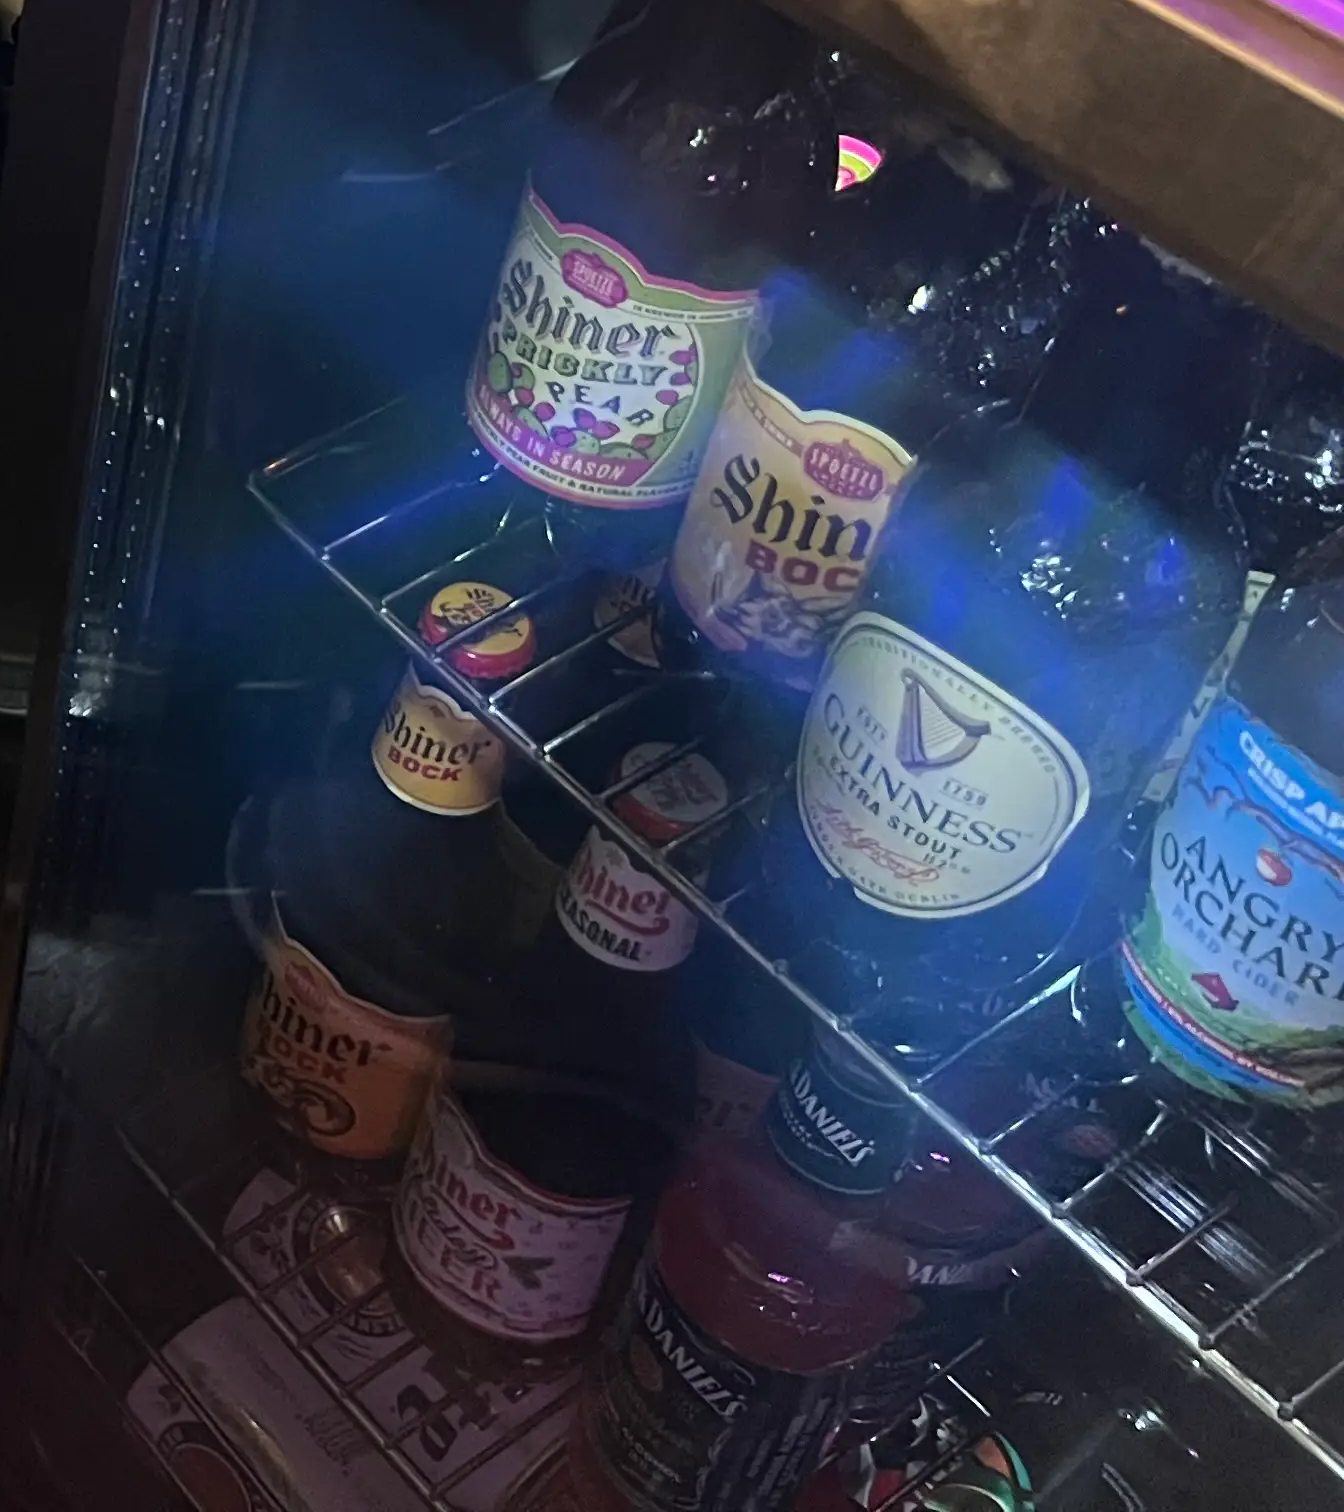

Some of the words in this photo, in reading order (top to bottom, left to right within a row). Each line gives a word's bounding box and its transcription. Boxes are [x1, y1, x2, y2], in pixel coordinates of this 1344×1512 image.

[500, 316, 668, 386] PRICKLY
[501, 257, 681, 358] Shiner
[545, 380, 654, 427] PEAR
[526, 432, 546, 459] IN
[549, 448, 626, 482] SEASON
[383, 695, 491, 767] Shiner
[386, 746, 462, 782] BOCK
[823, 692, 1023, 854] GUINNESS
[1238, 729, 1307, 801] CRISP
[828, 754, 882, 817] EXTRA
[886, 815, 963, 860] STOUT
[942, 779, 988, 807] 1759
[1160, 831, 1344, 1003] ORCHAR
[1185, 835, 1344, 964] ANGRY
[1171, 903, 1222, 954] HARD
[1232, 957, 1299, 1007] CIDER
[793, 1068, 876, 1168] DANIEL'S
[643, 1296, 749, 1423] DANIEL'S
